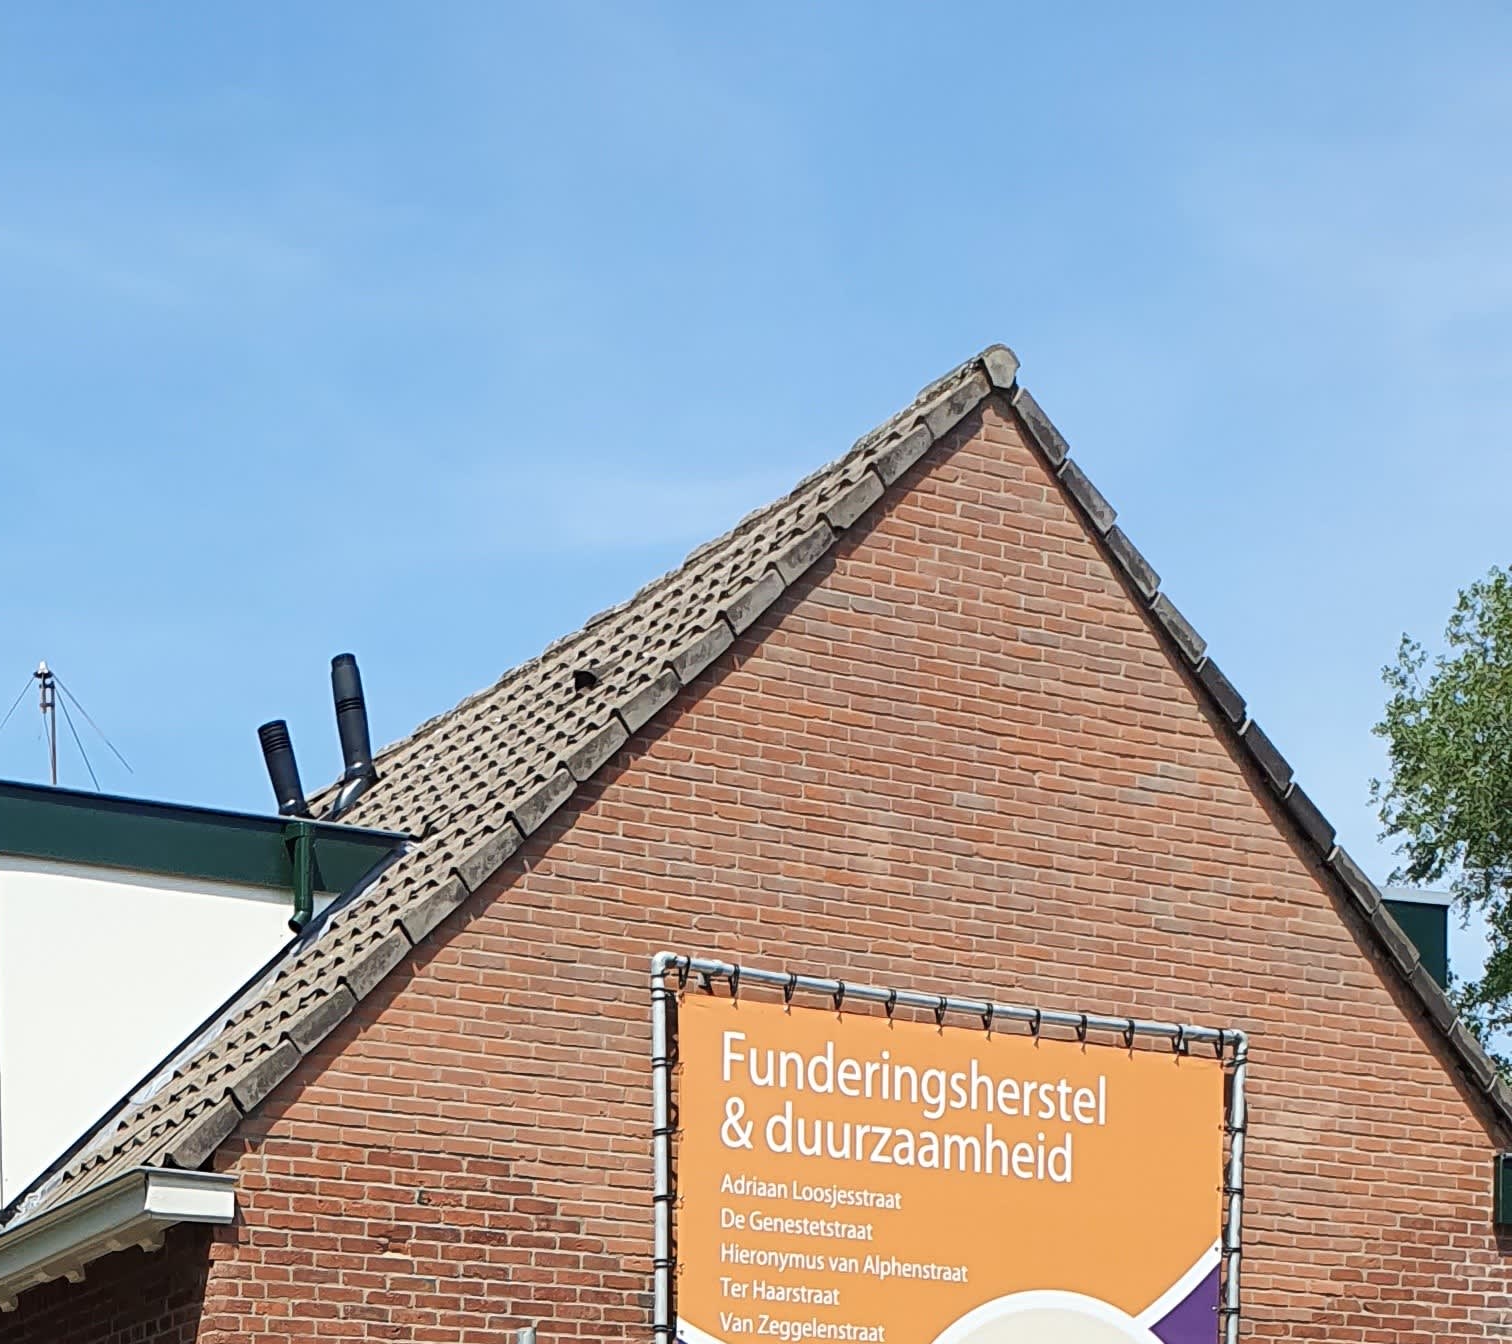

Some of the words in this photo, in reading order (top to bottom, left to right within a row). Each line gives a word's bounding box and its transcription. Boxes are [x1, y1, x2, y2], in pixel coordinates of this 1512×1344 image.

[721, 1031, 1107, 1126] Funderingsherstel
[720, 1096, 753, 1150] &
[765, 1101, 1074, 1184] duurzaamheid
[720, 1173, 788, 1199] Adriaan
[792, 1180, 902, 1210] Loosjesstraat
[720, 1208, 745, 1230] De
[749, 1211, 873, 1241] Genestetstraat
[720, 1243, 825, 1272] Hieronymus
[829, 1256, 859, 1274] van
[863, 1254, 969, 1283] Alphenstraat
[720, 1277, 749, 1299] Ter
[752, 1280, 840, 1306] Haarstraat
[719, 1312, 753, 1334] Van
[757, 1314, 885, 1343] Zeggelenstraat
